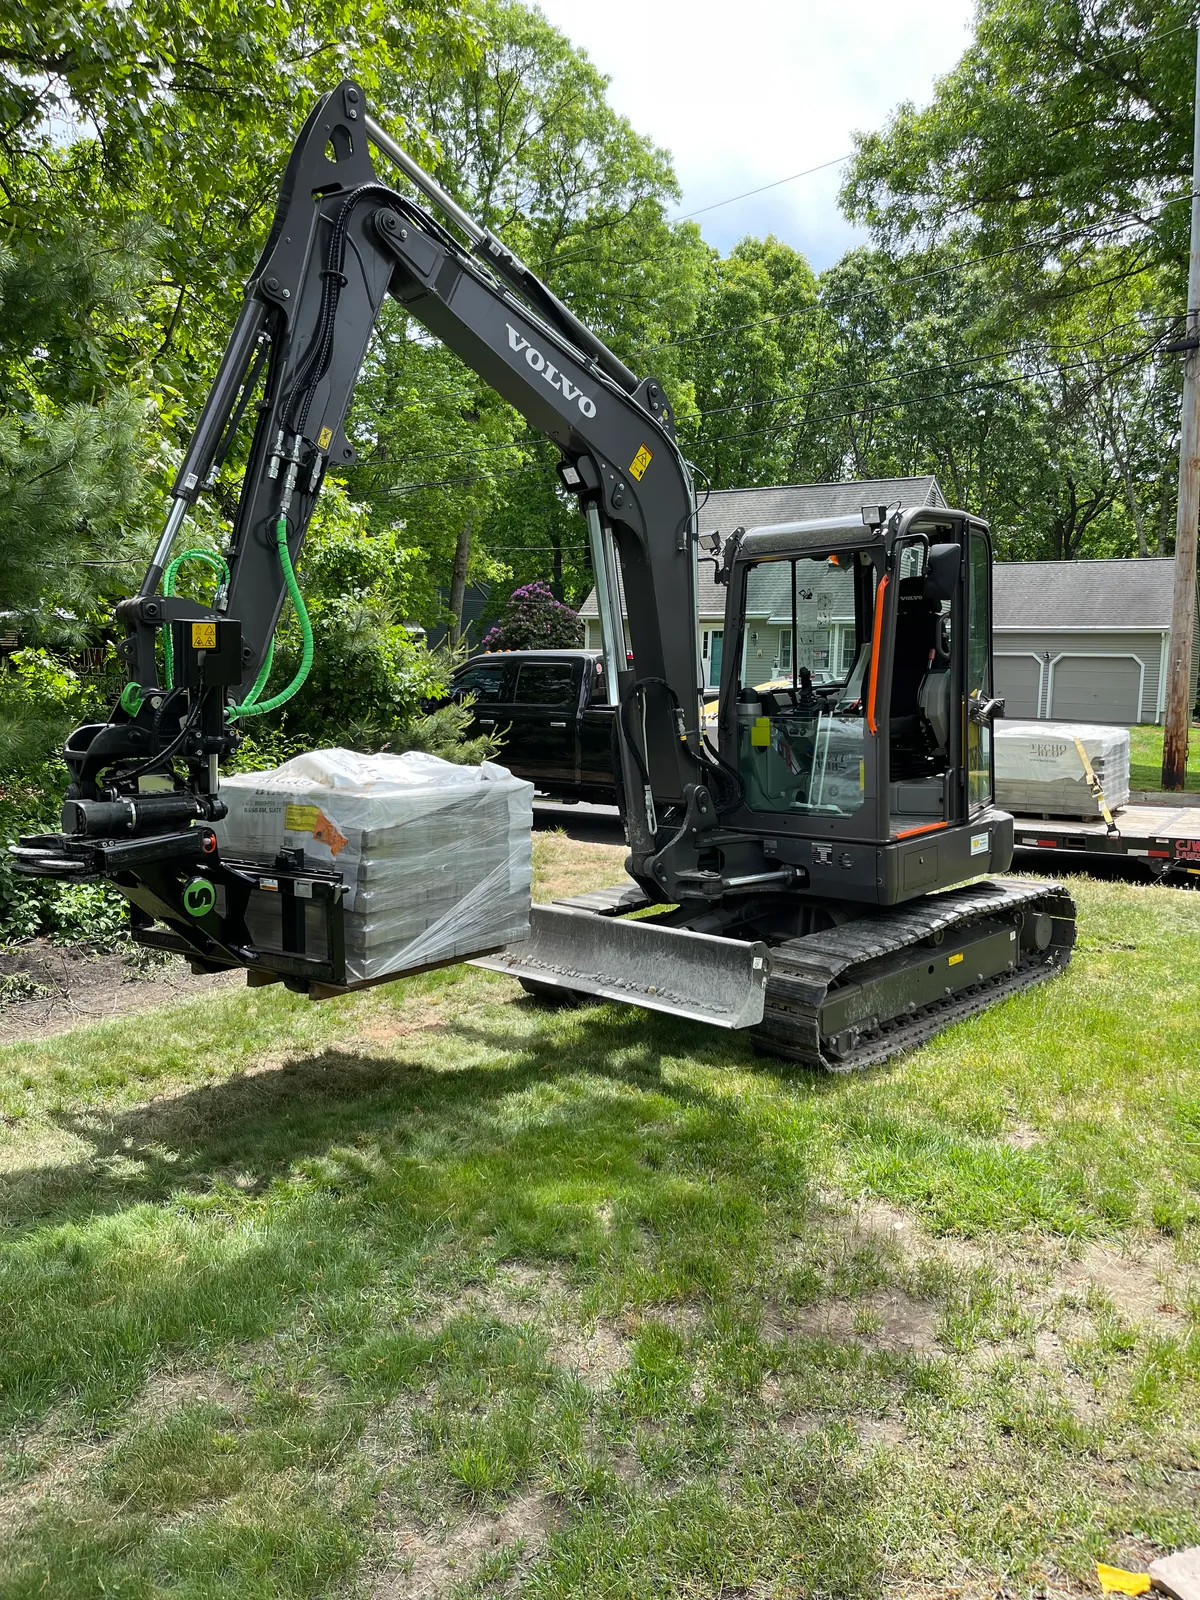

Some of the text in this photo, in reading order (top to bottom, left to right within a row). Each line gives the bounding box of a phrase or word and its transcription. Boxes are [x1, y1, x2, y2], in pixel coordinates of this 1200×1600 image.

[505, 323, 597, 419] VOLVO
[1029, 743, 1067, 752] TECHO
[1175, 839, 1200, 852] CJW
